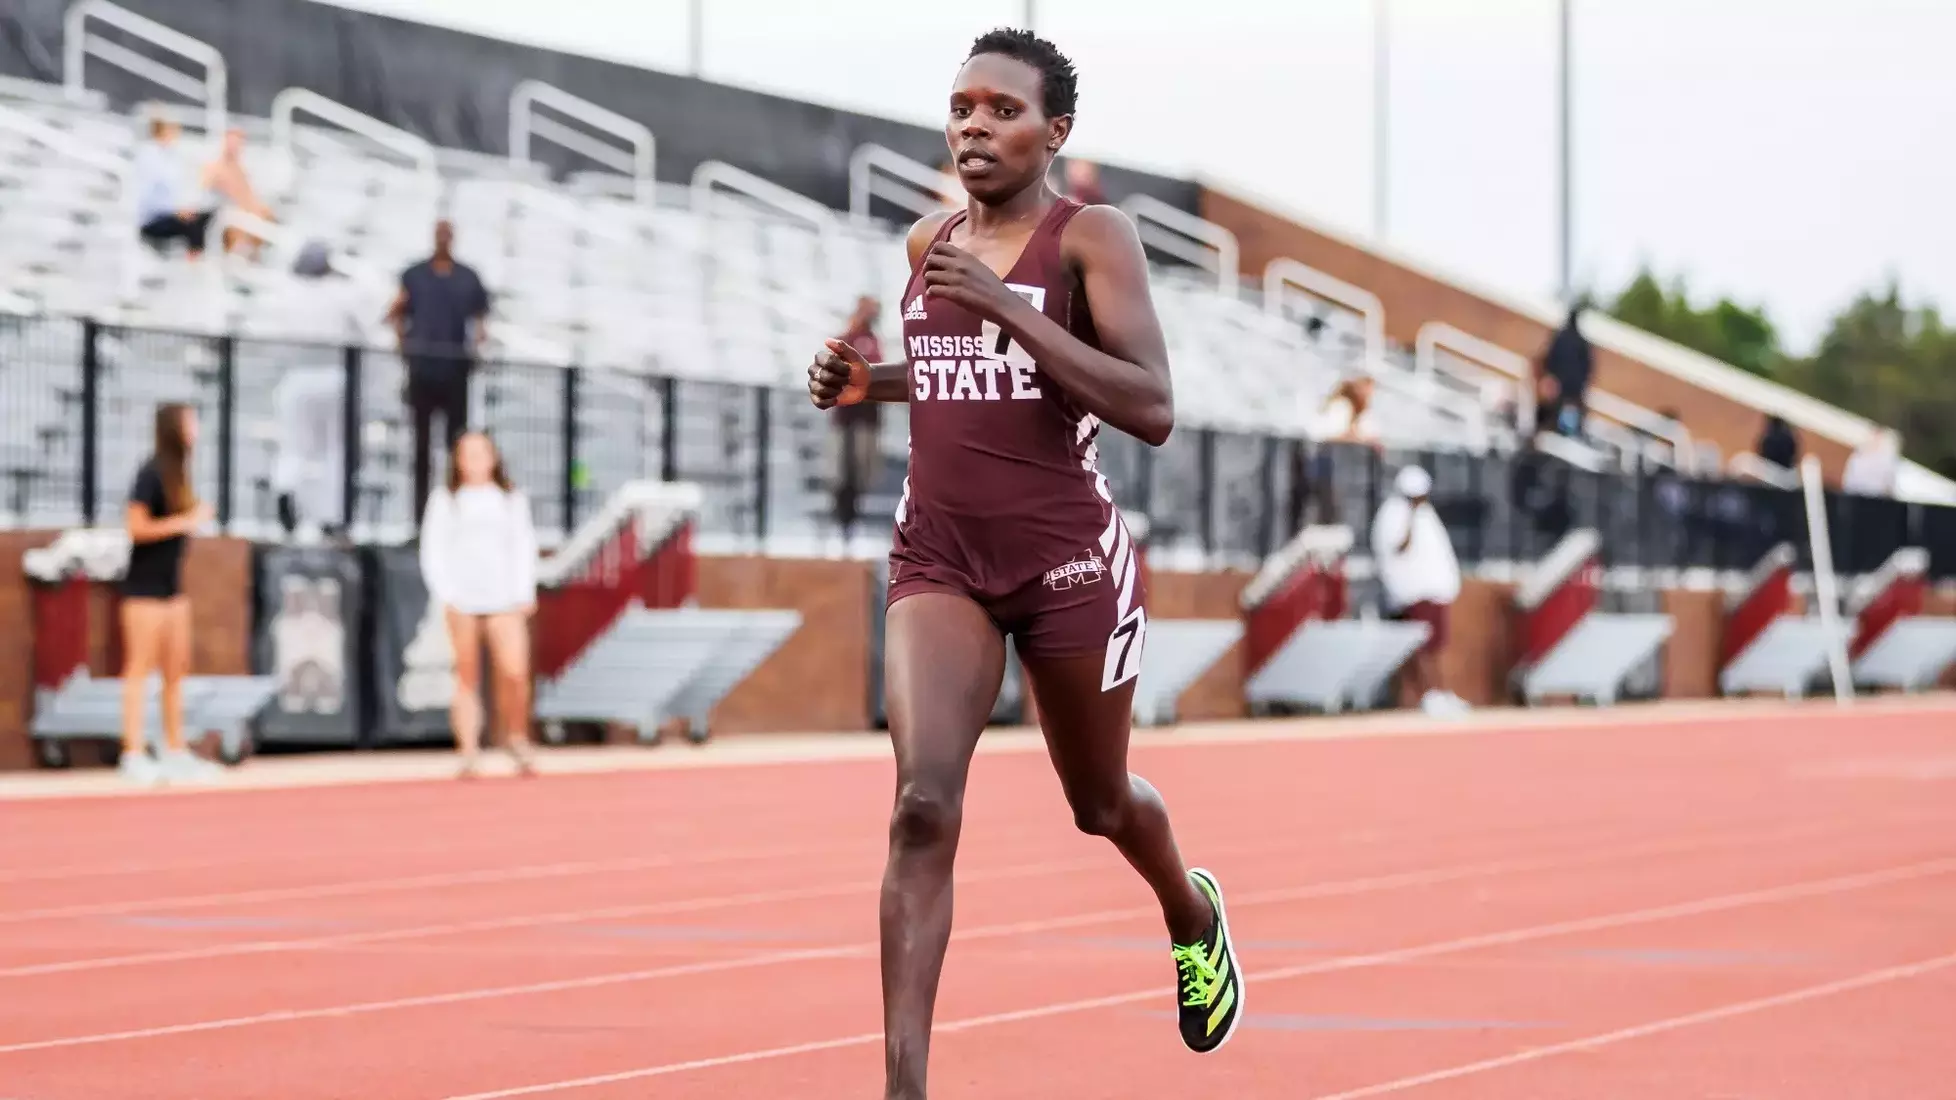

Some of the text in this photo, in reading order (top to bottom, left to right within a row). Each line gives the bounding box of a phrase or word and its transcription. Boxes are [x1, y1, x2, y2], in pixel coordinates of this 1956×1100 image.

[914, 360, 1042, 400] STATE
[1053, 562, 1094, 577] STATE
[1113, 616, 1139, 683] 7
